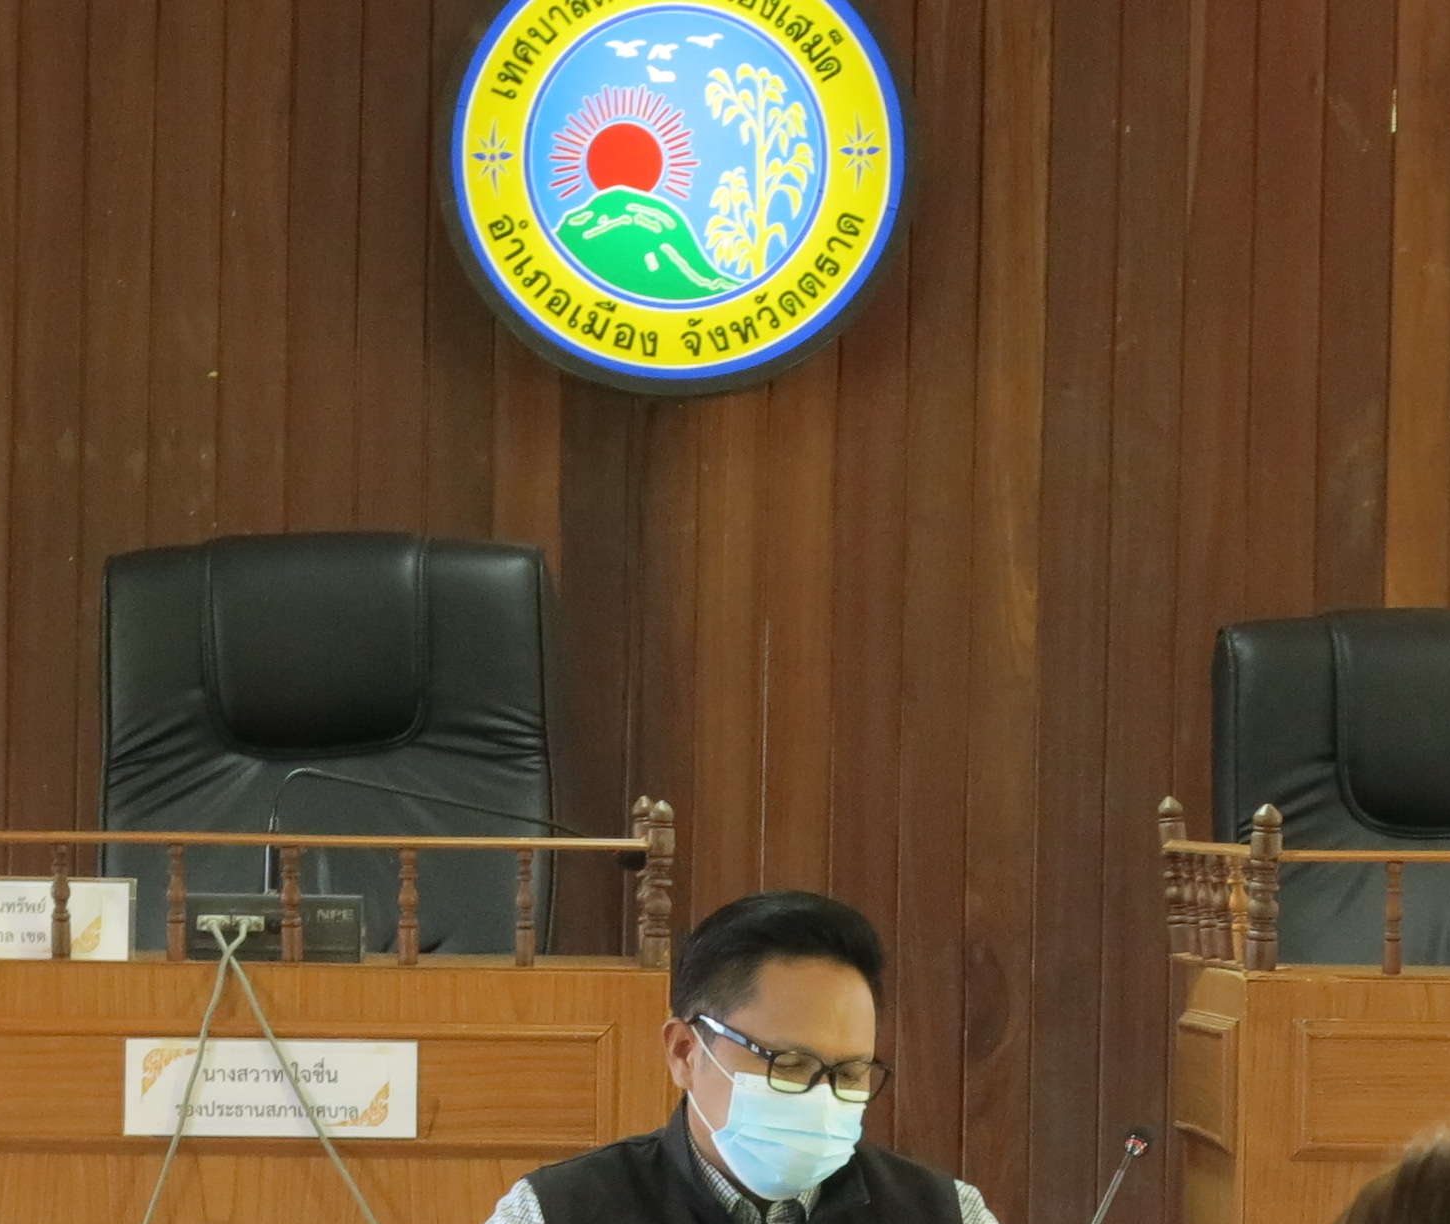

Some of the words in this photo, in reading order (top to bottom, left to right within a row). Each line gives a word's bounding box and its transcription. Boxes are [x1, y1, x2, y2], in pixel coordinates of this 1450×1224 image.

[489, 214, 657, 357] อำเภอเมือง
[680, 211, 864, 357] จังหวัดตราด
[203, 1066, 284, 1084] นางสวาท
